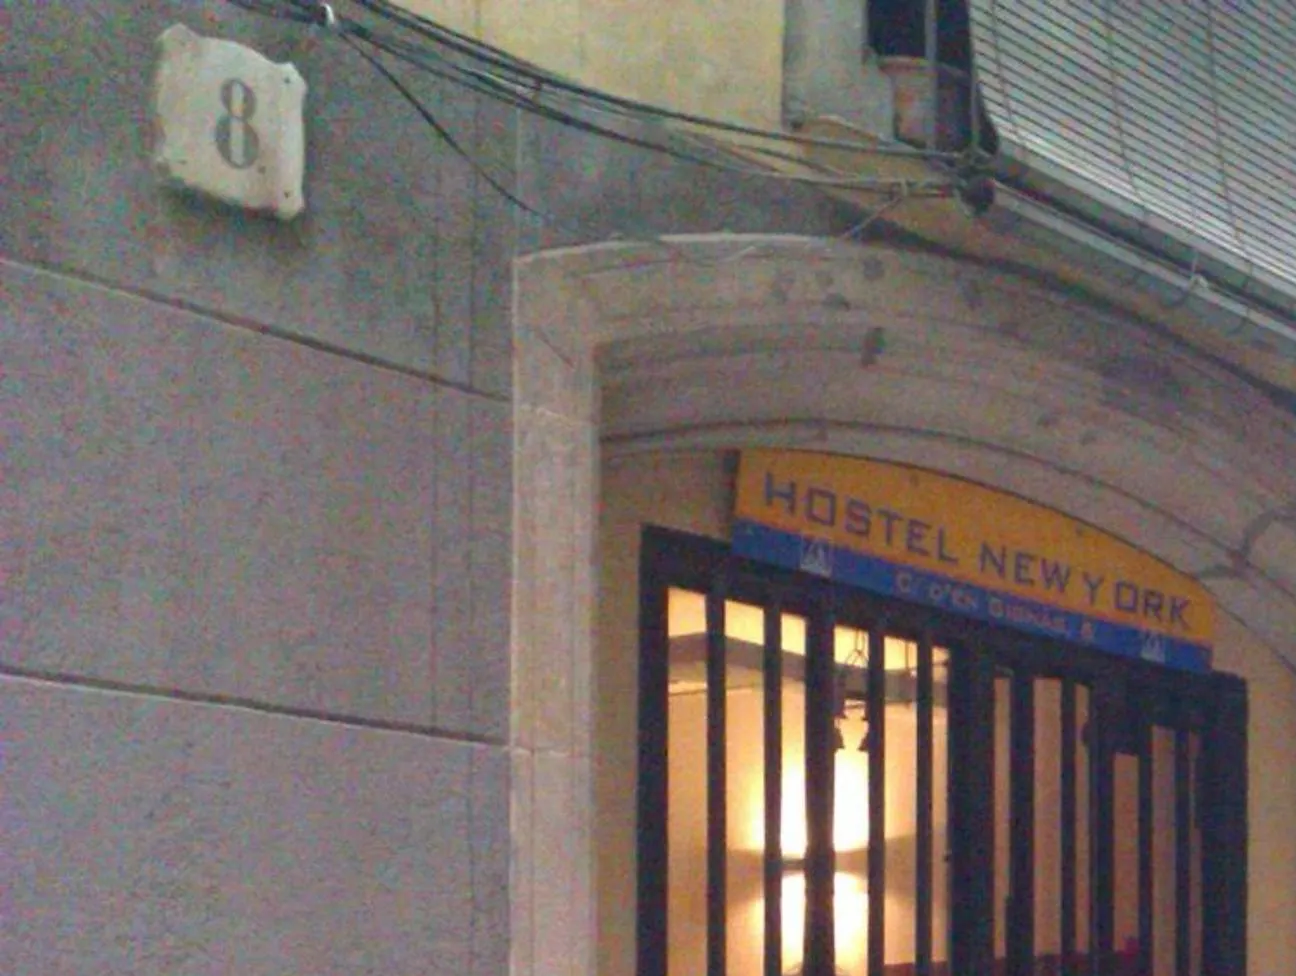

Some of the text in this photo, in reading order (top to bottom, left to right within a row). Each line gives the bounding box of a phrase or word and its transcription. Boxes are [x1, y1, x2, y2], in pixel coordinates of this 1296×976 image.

[214, 77, 260, 170] 8
[763, 471, 960, 566] HOSTEL
[979, 541, 1072, 594] NEW
[1082, 574, 1193, 631] YORK
